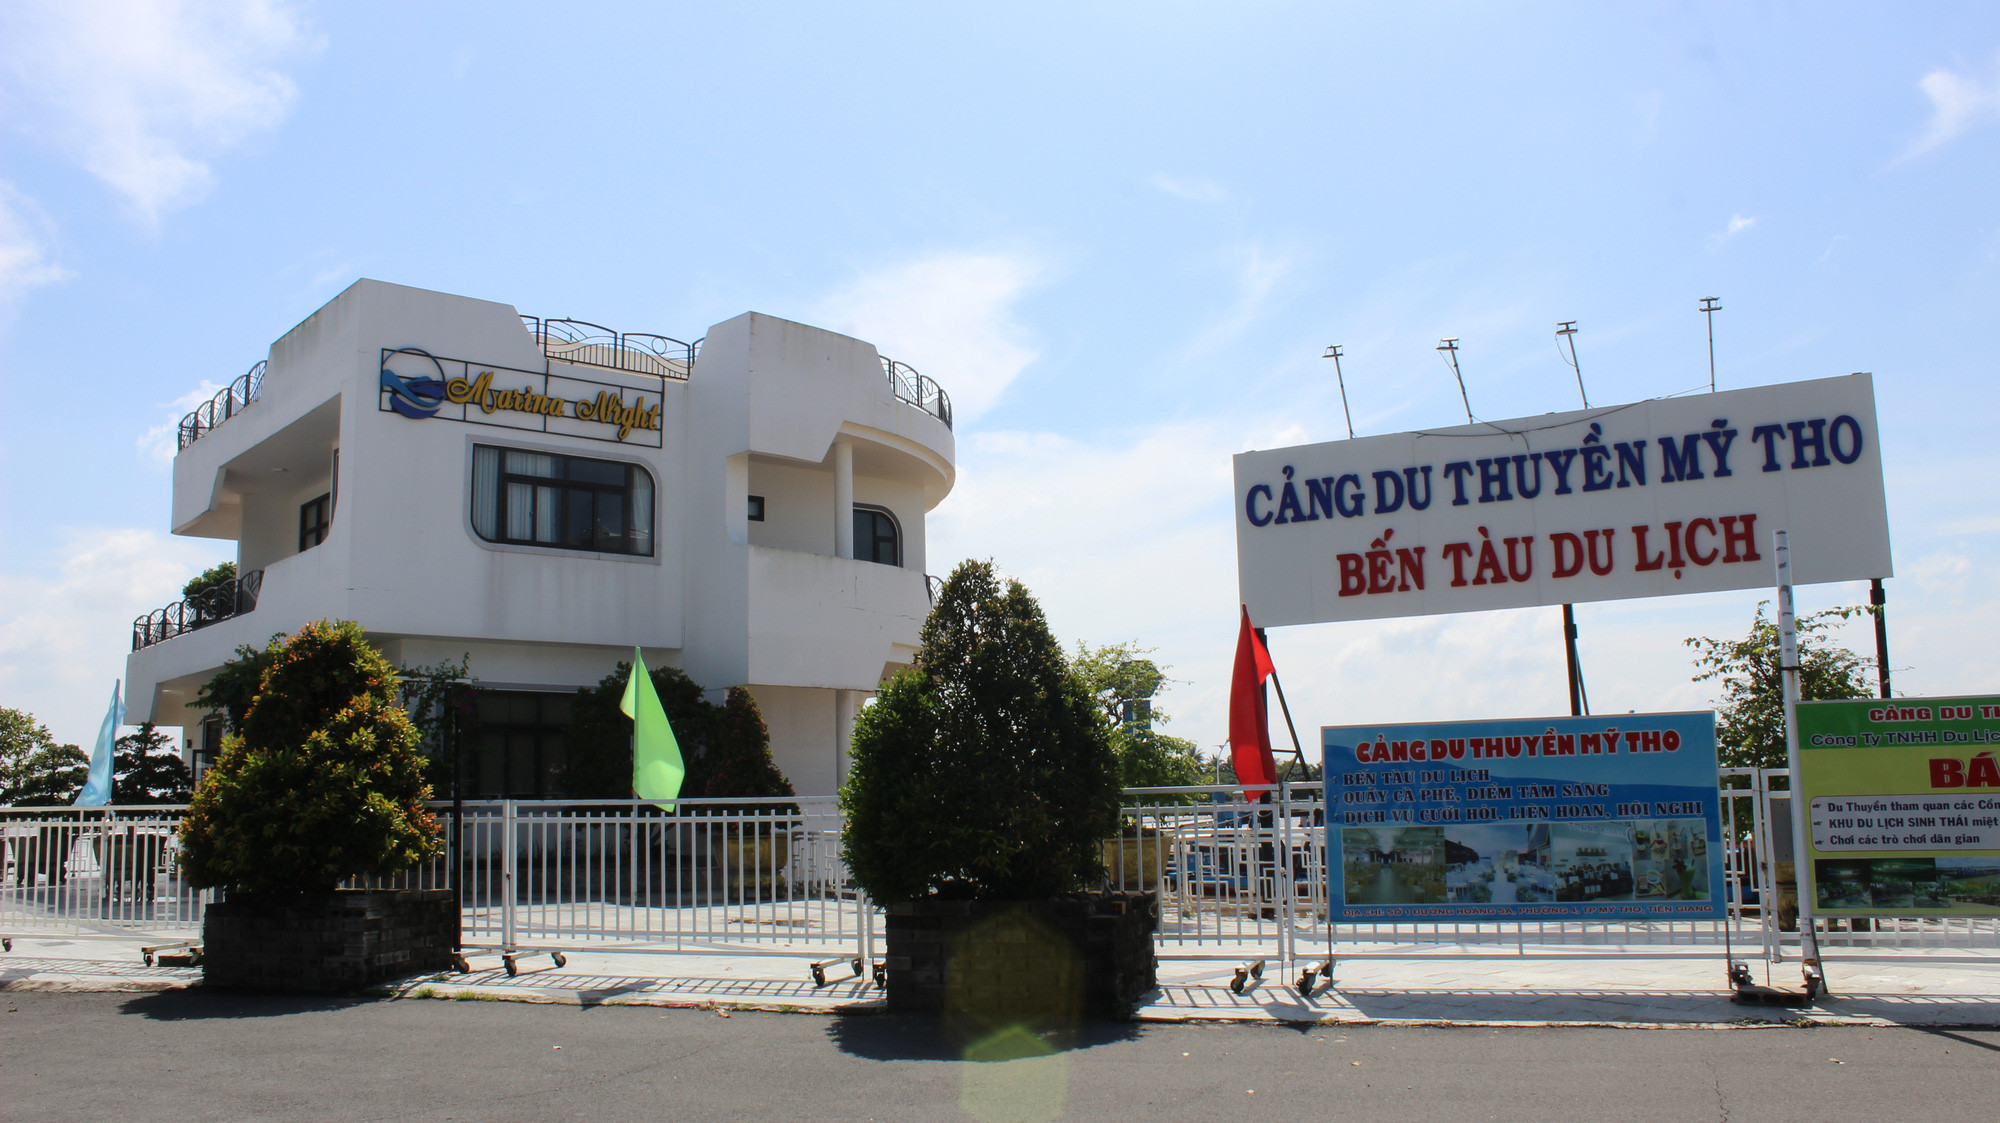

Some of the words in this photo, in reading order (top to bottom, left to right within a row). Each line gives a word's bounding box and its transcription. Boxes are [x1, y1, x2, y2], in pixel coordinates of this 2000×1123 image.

[446, 371, 566, 417] Marina
[575, 390, 662, 440] Night
[1246, 465, 1365, 527] CẢNG
[1372, 465, 1432, 514] DU
[1443, 423, 1647, 506] THUYỀN
[1658, 419, 1738, 483] MỸ
[1752, 415, 1863, 473] THO
[1336, 528, 1426, 597] BẾN
[1442, 526, 1534, 587] TÀU
[1550, 529, 1615, 578] DU
[1632, 514, 1761, 580] LỊCH
[1868, 704, 1933, 723] CẢNG
[1939, 705, 1973, 720] DU
[1355, 733, 1427, 763] CẢNG
[1430, 738, 1466, 760] DU
[1469, 727, 1576, 759] THUYỀN
[1580, 727, 1621, 755] MỸ
[1624, 729, 1682, 754] THO
[1810, 733, 1857, 748] Công
[1861, 732, 1882, 746] Ty
[1885, 731, 1938, 744] TNHH
[1943, 730, 1968, 743] Du
[1342, 769, 1376, 786] BẾN
[1381, 769, 1415, 785] TÀU
[1420, 770, 1444, 784] DU
[1450, 768, 1491, 785] LỊCH
[1393, 788, 1416, 803] CÀ
[1518, 782, 1557, 799] TÂM
[1562, 781, 1610, 798] SÁNG
[1344, 809, 1386, 825] DỊCH
[1390, 809, 1415, 823] VỤ
[1509, 803, 1550, 819] LIÊN
[1555, 804, 1611, 819] HOAN,
[1616, 800, 1650, 818] HỘI
[1655, 800, 1703, 817] NGHỊ
[1828, 802, 1843, 812] Du
[1846, 800, 1887, 814] Thuyền
[1890, 801, 1920, 811] tham
[1923, 802, 1950, 813] quan
[1954, 800, 1975, 810] các
[1829, 818, 1853, 828] KHU
[1857, 818, 1874, 828] DU
[1877, 817, 1904, 830] LỊCH
[1908, 817, 1936, 828] SINH
[1939, 814, 1968, 827] THÁI
[1972, 816, 1999, 829] miệt
[1830, 834, 1855, 845] Chơi
[1858, 834, 1879, 845] các
[1881, 834, 1899, 844] trò
[1903, 834, 1927, 844] chơi
[1930, 833, 1951, 844] dân
[1955, 833, 1980, 845] gian
[1404, 907, 1410, 916] 1
[1456, 906, 1497, 916] HOÀNG
[1675, 904, 1713, 913] GIANG
